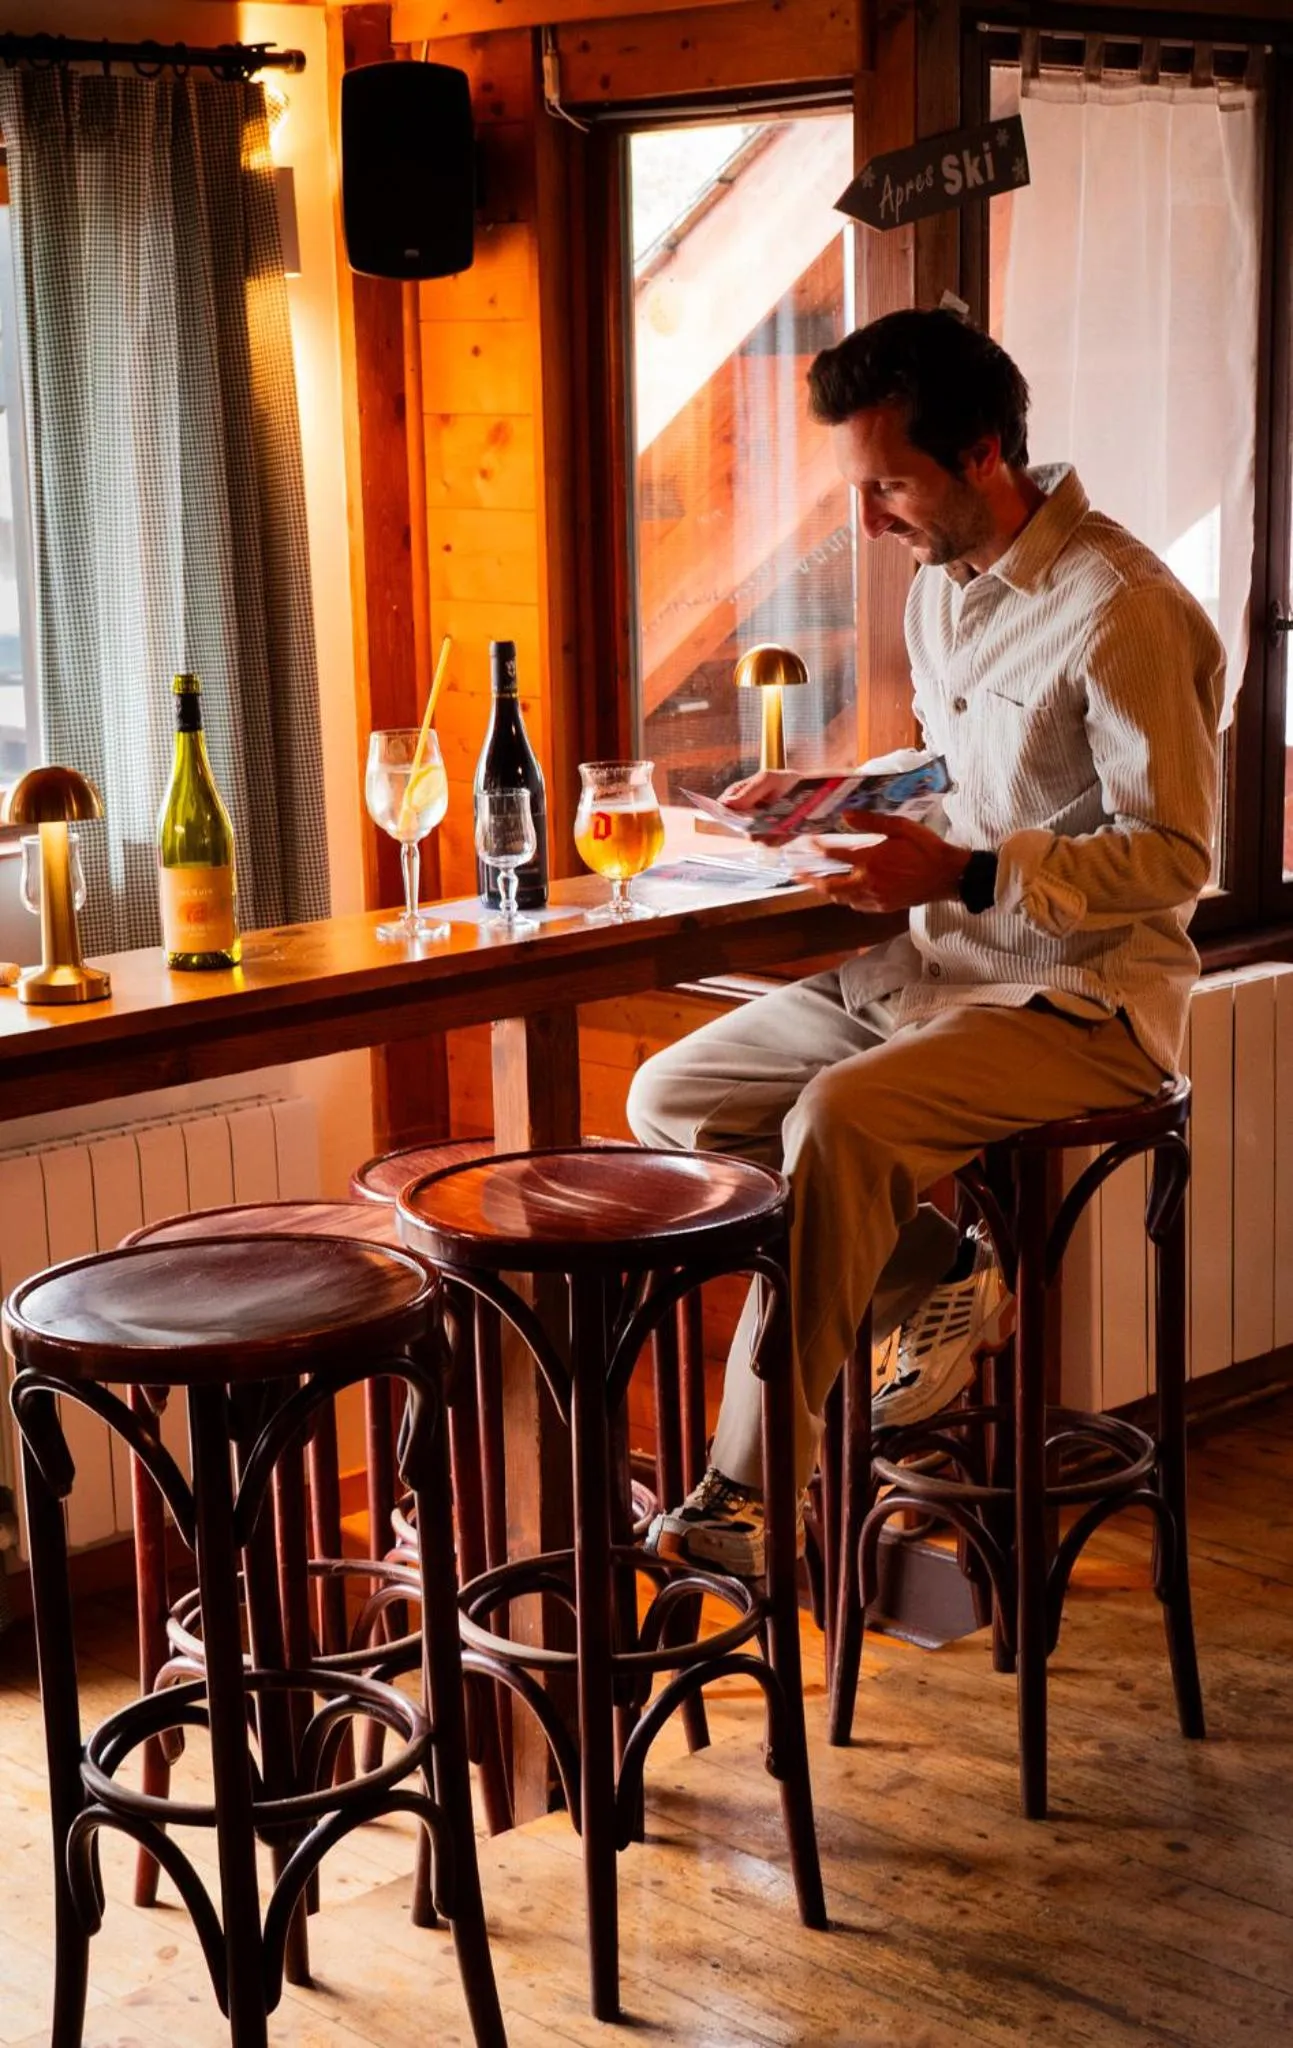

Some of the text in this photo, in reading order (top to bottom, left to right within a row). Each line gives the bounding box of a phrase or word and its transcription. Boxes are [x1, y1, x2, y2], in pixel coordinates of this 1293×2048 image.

[879, 141, 995, 222] Apres Ski
[593, 811, 612, 841] D
